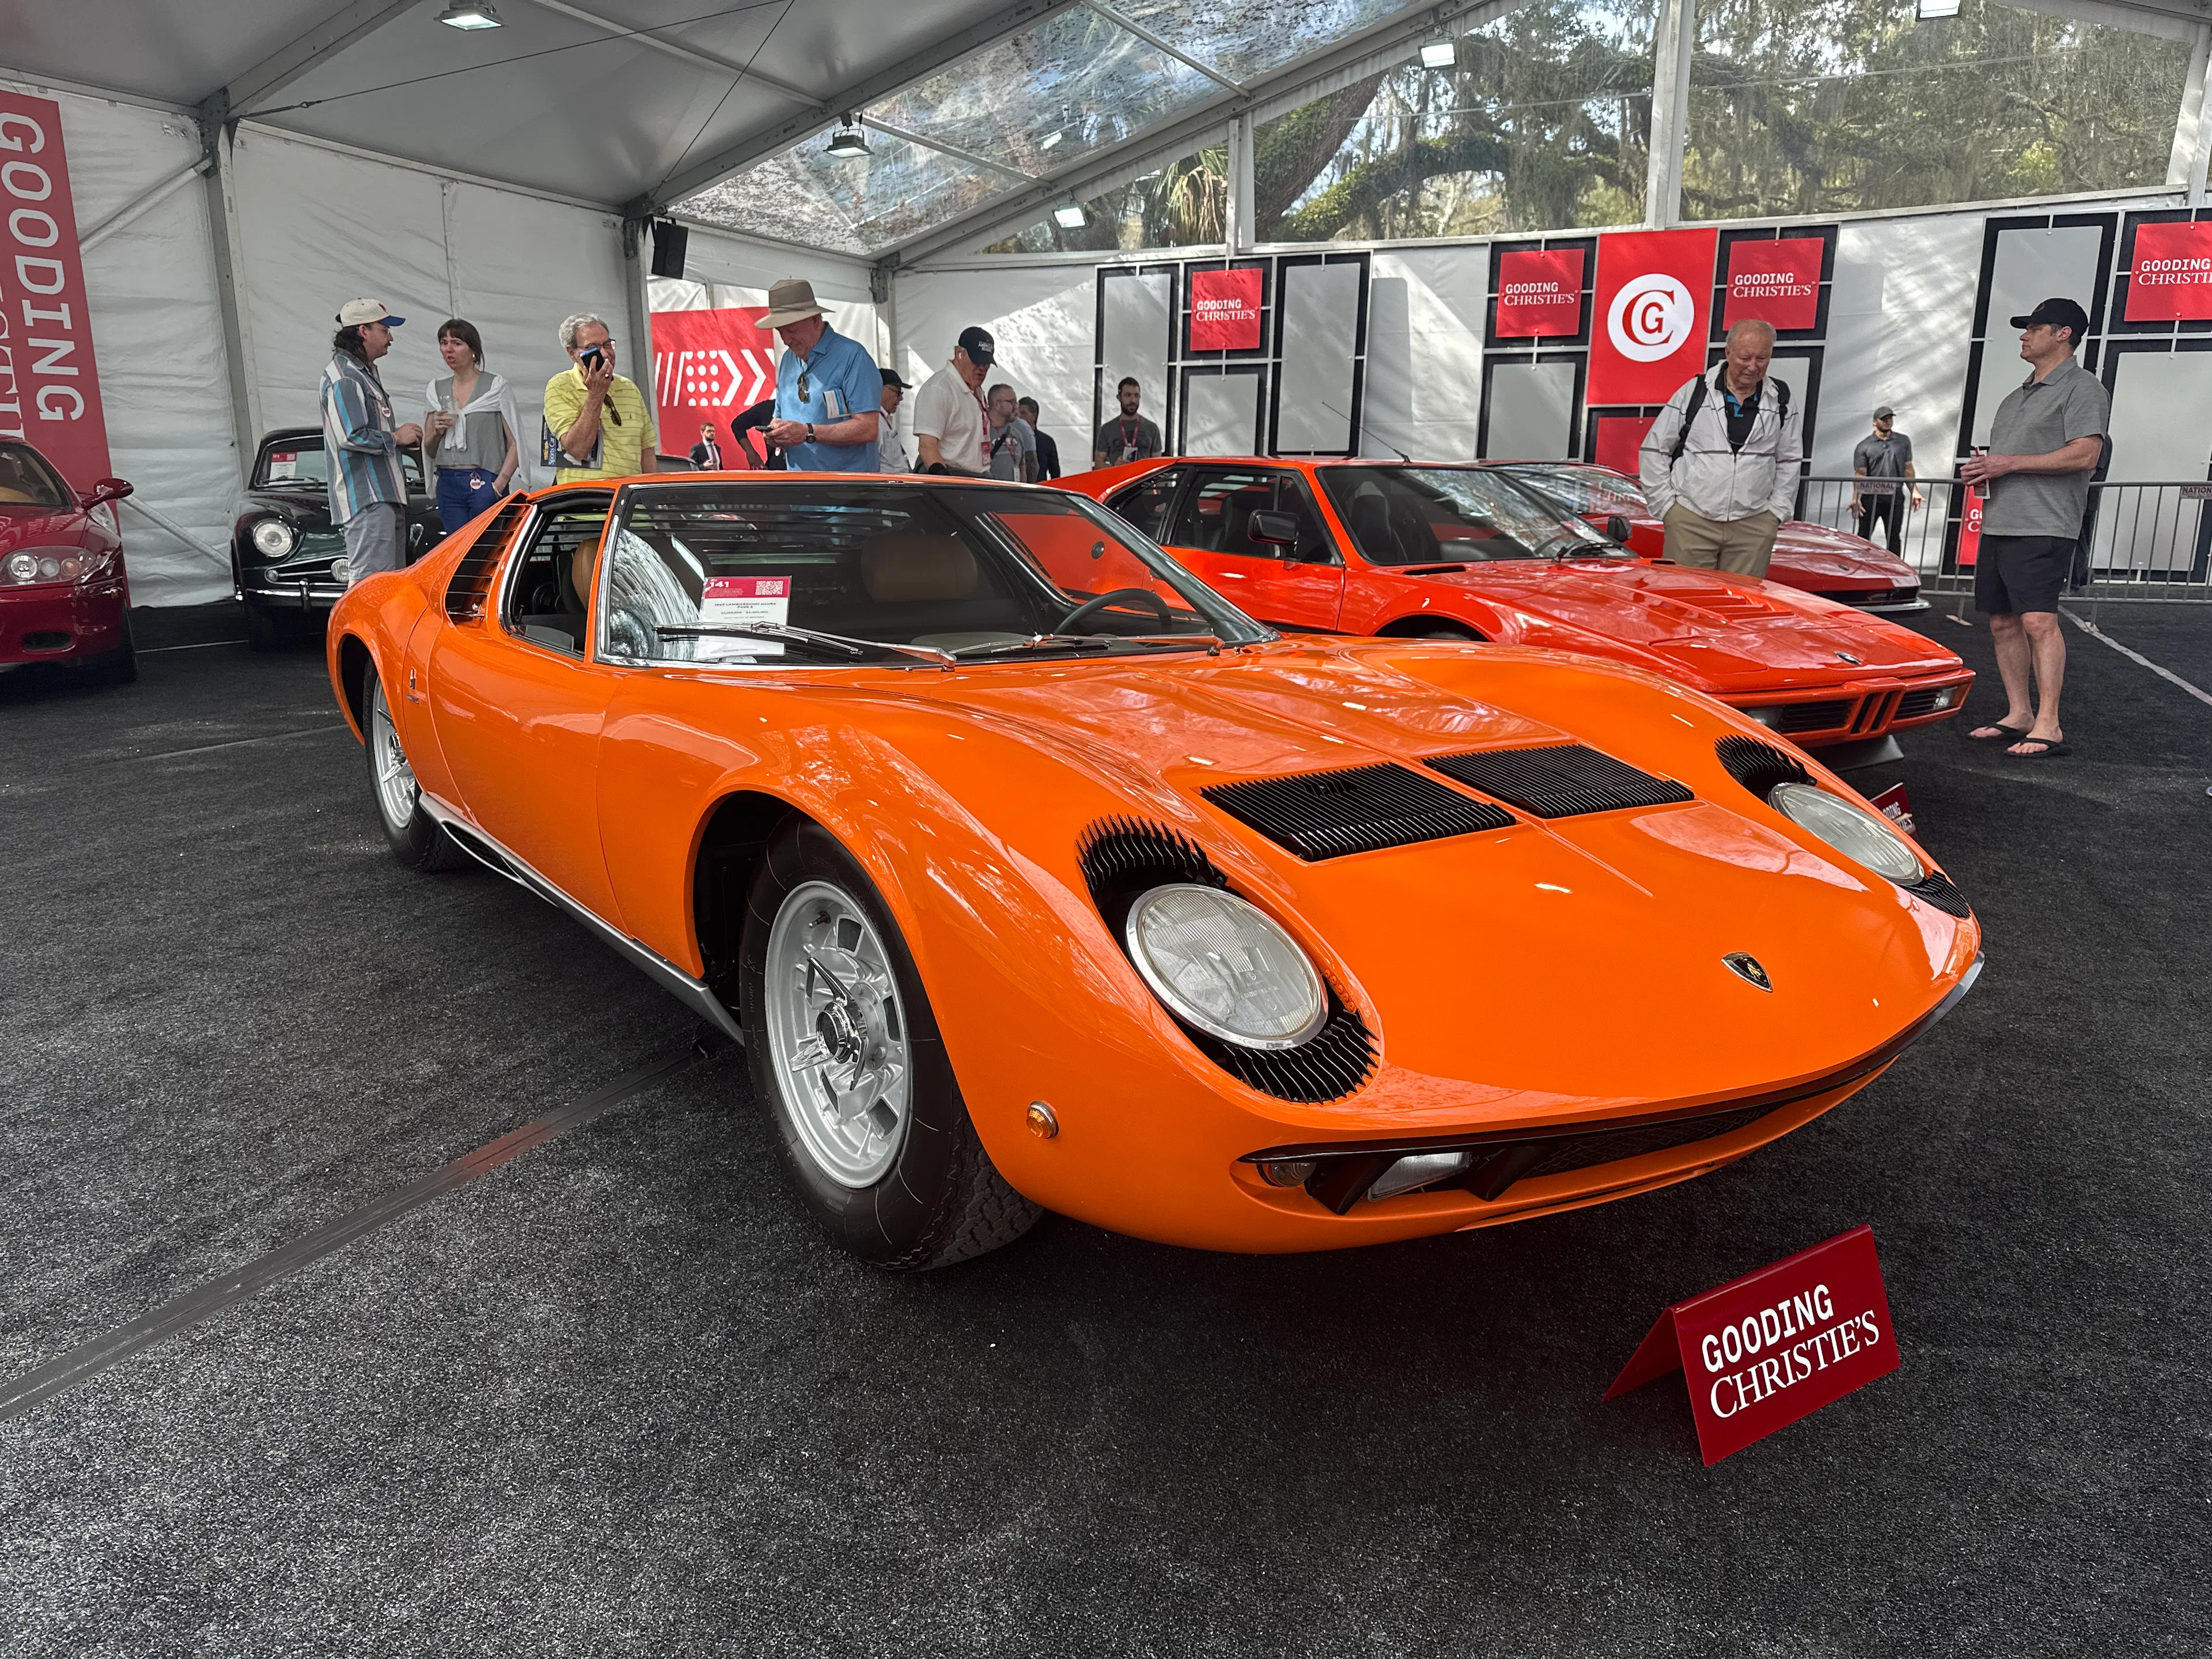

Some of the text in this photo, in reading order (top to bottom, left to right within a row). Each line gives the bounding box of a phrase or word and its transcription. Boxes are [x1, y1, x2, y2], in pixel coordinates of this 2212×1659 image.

[0, 112, 85, 421] GOODING
[2141, 258, 2211, 272] GOODING
[1735, 272, 1794, 285] GOODING
[1505, 282, 1559, 294] GOODING
[1733, 285, 1812, 298] CHRISTIE'S
[1196, 299, 1242, 310] GOODING
[1504, 293, 1575, 306] CHRISTIE'S
[1196, 310, 1256, 321] CHRISTIE'S
[1702, 1284, 1834, 1373] GOODING
[1710, 1309, 1880, 1418] CHRISTIE'S
